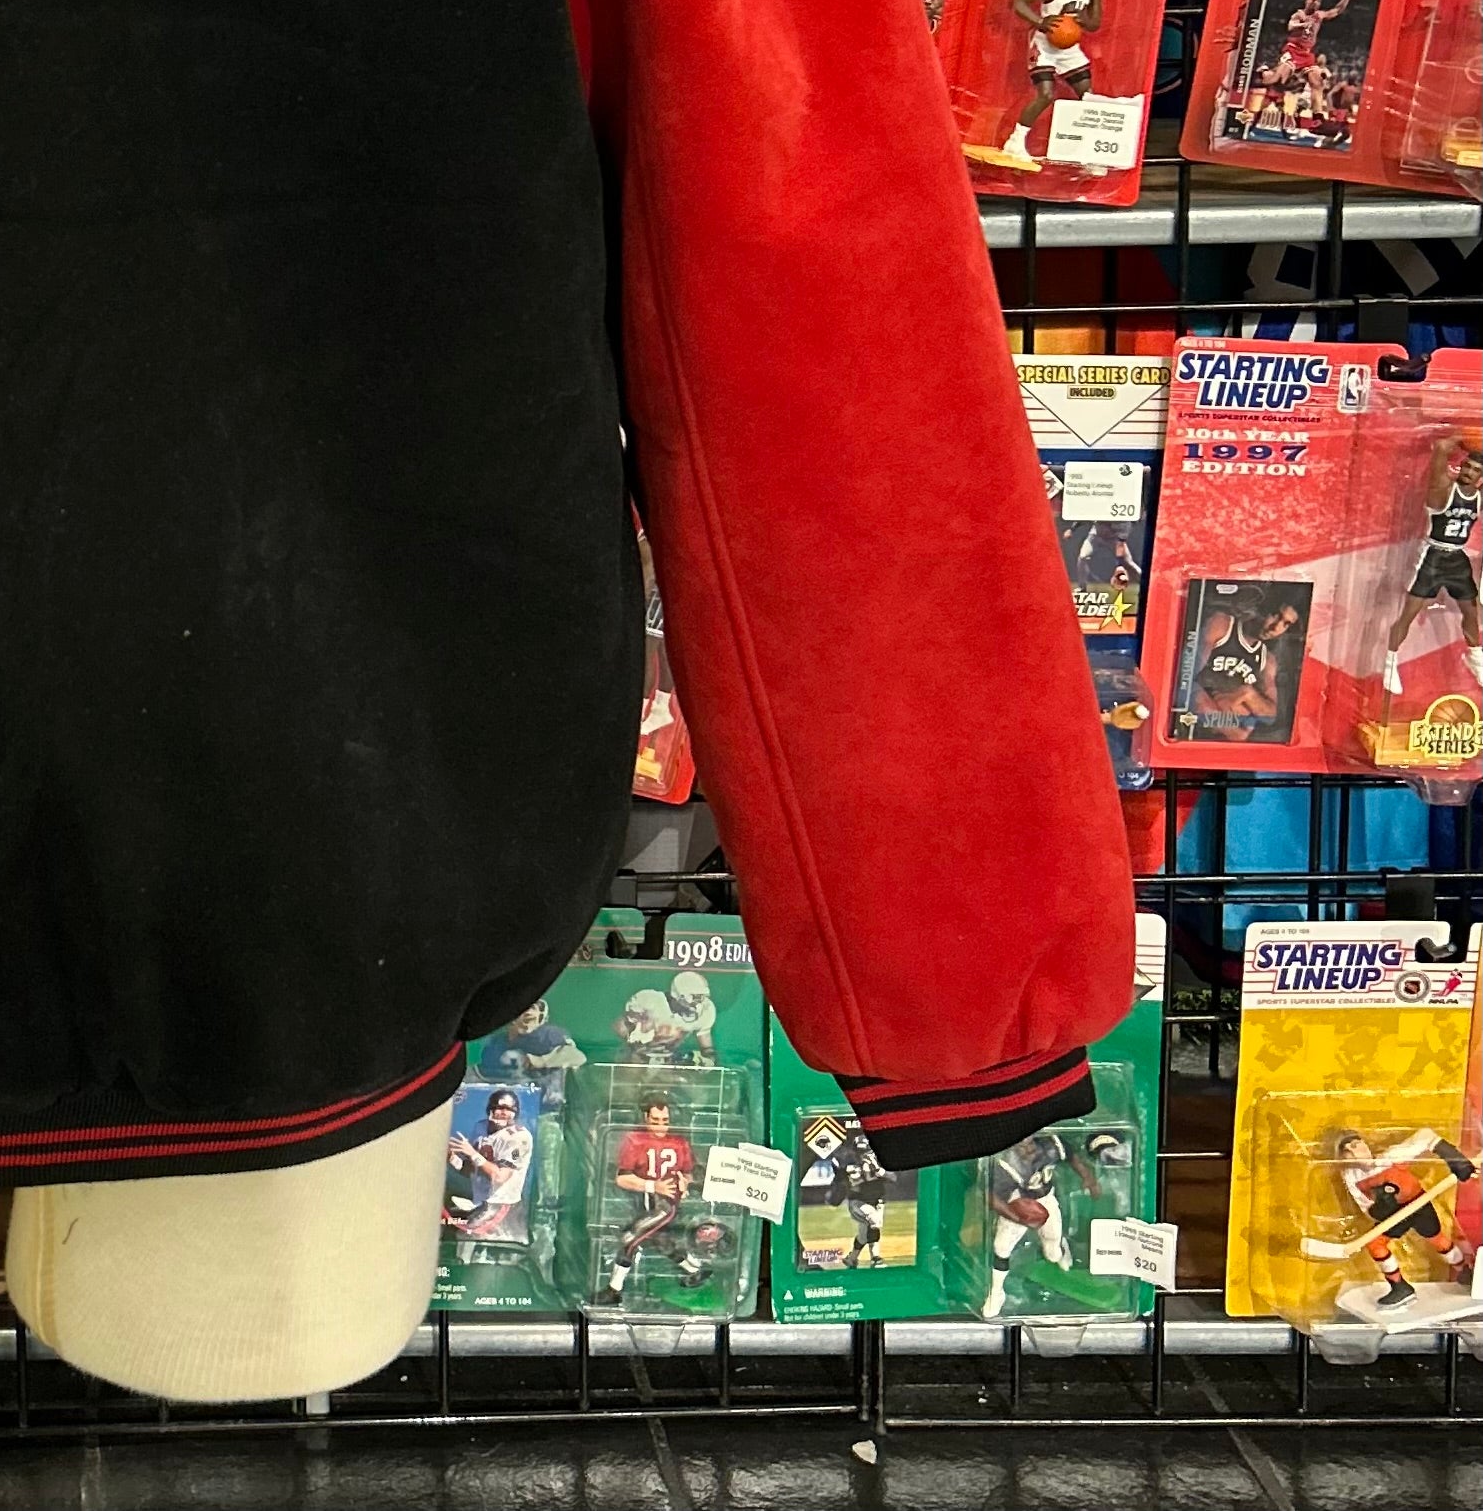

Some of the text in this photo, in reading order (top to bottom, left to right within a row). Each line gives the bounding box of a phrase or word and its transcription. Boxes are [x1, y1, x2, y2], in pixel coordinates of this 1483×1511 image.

[1239, 18, 1261, 76] RODMAN
[1093, 140, 1119, 154] $30
[1017, 365, 1172, 386] SPECIAL SERIES CARD
[1179, 354, 1330, 384] STARTING
[1069, 387, 1115, 398] INCLUDED
[1199, 380, 1308, 409] LINEUP
[1185, 428, 1310, 443] 10th YEAR
[1183, 443, 1307, 462] 1997
[1181, 461, 1306, 477] EDITION
[1110, 503, 1136, 517] $20
[1444, 519, 1469, 538] 21
[1203, 711, 1240, 729] SPURS
[1427, 740, 1476, 755] SERIES
[667, 935, 753, 968] 1998 EDIT
[1257, 943, 1403, 969] STARTING
[1277, 967, 1382, 991] LINEUP
[1256, 997, 1396, 1006] SPORTS SUPERSTAR COLLECTIBLES
[646, 1148, 678, 1177] 12
[745, 1185, 769, 1203] $20
[1134, 1257, 1158, 1273] $20
